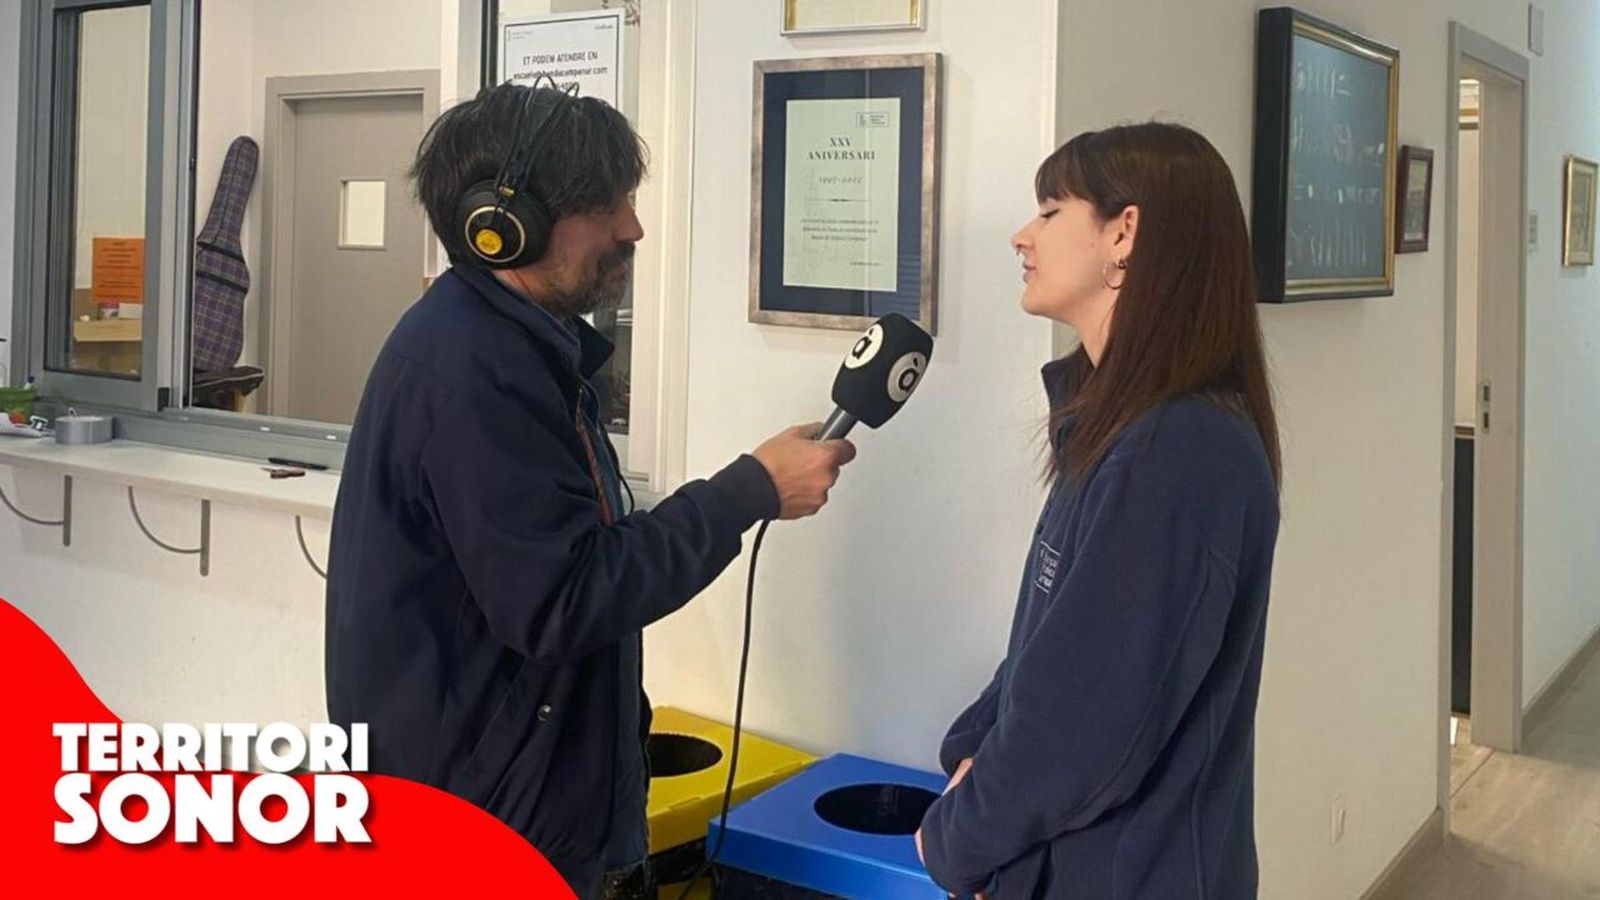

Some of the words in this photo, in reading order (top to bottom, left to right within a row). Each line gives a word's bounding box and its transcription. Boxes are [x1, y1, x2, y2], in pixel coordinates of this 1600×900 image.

[523, 56, 530, 66] ET
[532, 54, 556, 64] PODEM
[557, 52, 586, 63] ATENDRE
[588, 51, 598, 60] EN
[829, 137, 852, 147] XXV
[807, 151, 876, 160] ANIVERSARI
